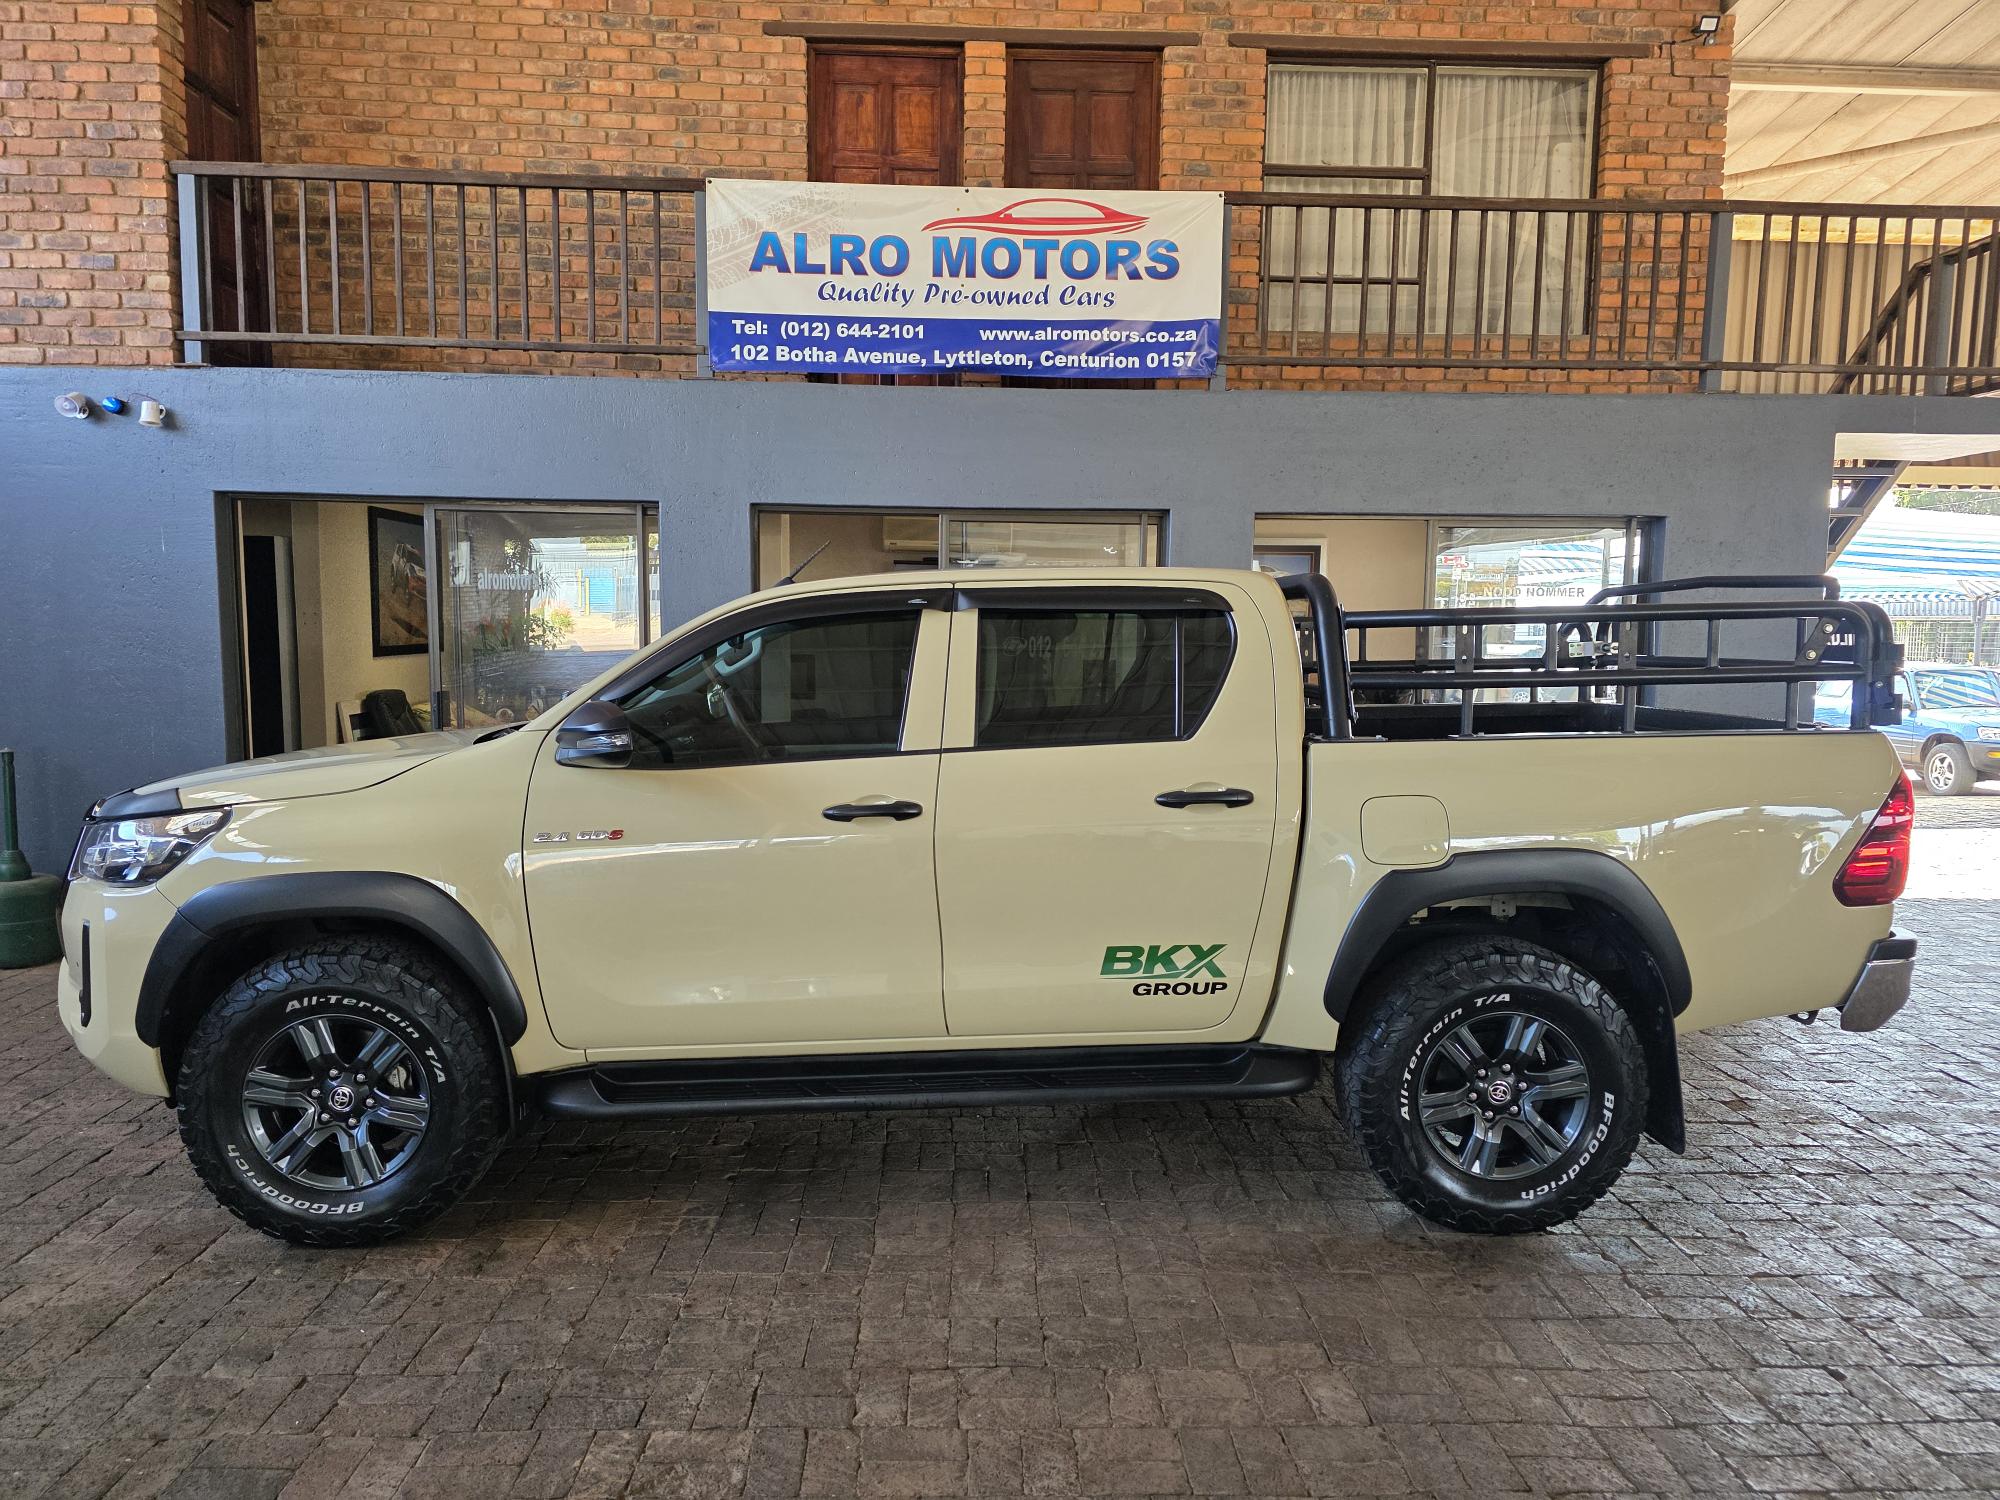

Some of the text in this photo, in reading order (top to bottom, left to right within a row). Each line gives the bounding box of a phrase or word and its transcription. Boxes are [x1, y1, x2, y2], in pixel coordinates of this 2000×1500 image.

[749, 231, 1180, 280] ALRO MOTORS
[817, 280, 1115, 308] Quality Pre-owned Cars
[731, 320, 924, 340] Tel: (012) 644-2101
[979, 327, 1197, 343] www.alromotors.co.za
[731, 344, 1197, 369] 102 Botha Avenue, Lyttleton, Centurion 0157
[1526, 587, 1585, 598] NOMMER
[1100, 944, 1228, 979] BKX
[1132, 982, 1228, 997] GROUP
[285, 994, 447, 1084] All-Terrain T/A
[1401, 993, 1511, 1121] All-Terrain T/A
[1521, 1092, 1615, 1201] BFGoodrich
[226, 1144, 366, 1215] BFGoodrich
